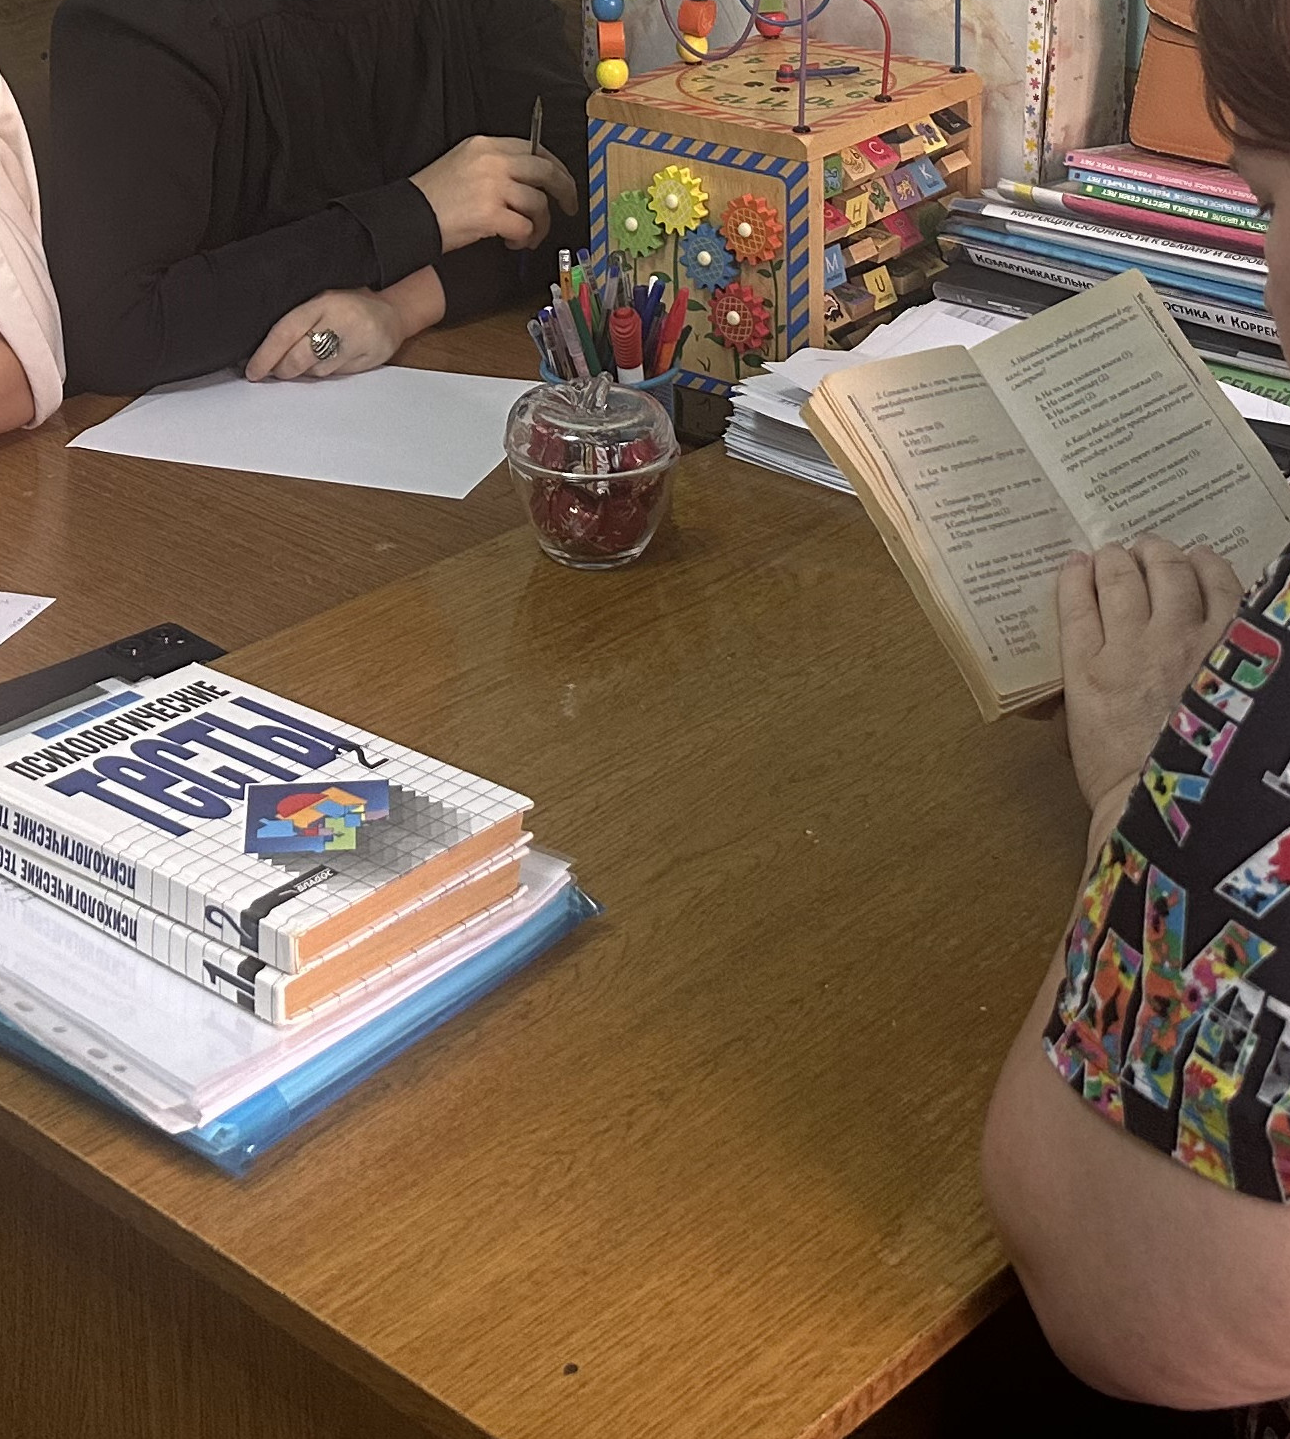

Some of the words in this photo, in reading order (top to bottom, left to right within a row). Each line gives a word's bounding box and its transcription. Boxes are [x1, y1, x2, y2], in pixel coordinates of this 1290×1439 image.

[853, 204, 862, 220] H
[1076, 222, 1150, 242] СКЛОННОСТИ
[1159, 239, 1210, 254] ОБМАНУ
[1211, 249, 1223, 257] И
[825, 252, 839, 274] M
[875, 275, 886, 293] U
[7, 679, 231, 781] ПСИХОЛОГИЧЕСКИЕ
[12, 811, 136, 889] ПСИХОЛОГИЧЕСКИЕ
[20, 859, 137, 941] ПСИХОЛОГИЧЕСКИЕ
[204, 905, 253, 940] 2
